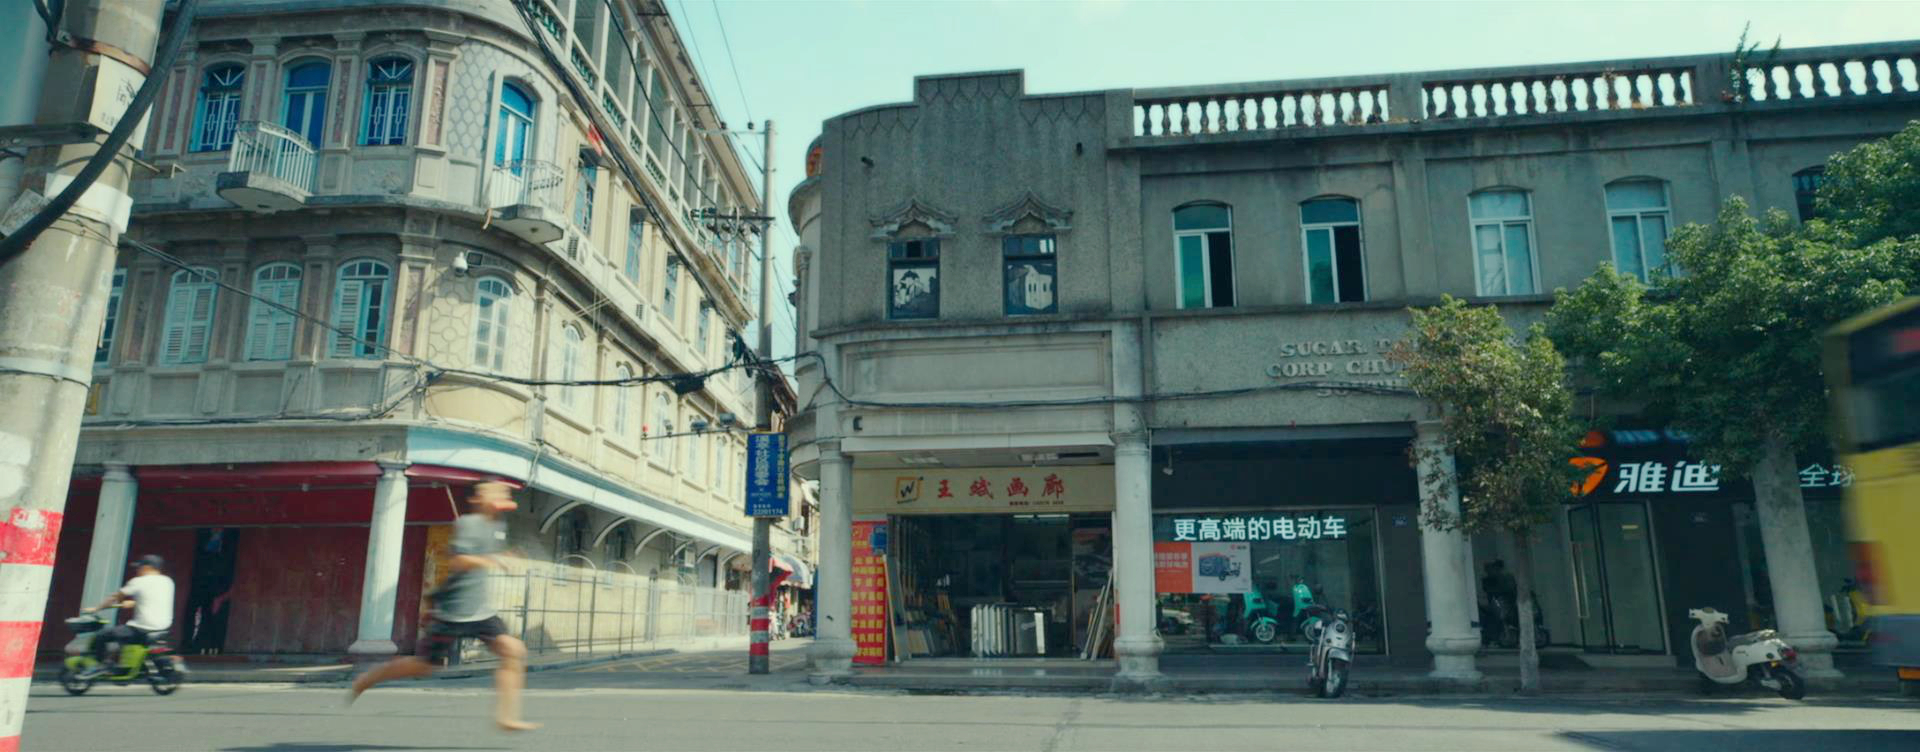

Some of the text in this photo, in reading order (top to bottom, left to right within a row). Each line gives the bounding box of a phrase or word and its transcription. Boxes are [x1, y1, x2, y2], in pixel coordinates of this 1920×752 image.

[1279, 339, 1368, 358] SUGAR
[1265, 360, 1333, 378] CORP
[1613, 460, 1721, 493] 雅迪
[1173, 515, 1348, 542] 更高端的电动车
